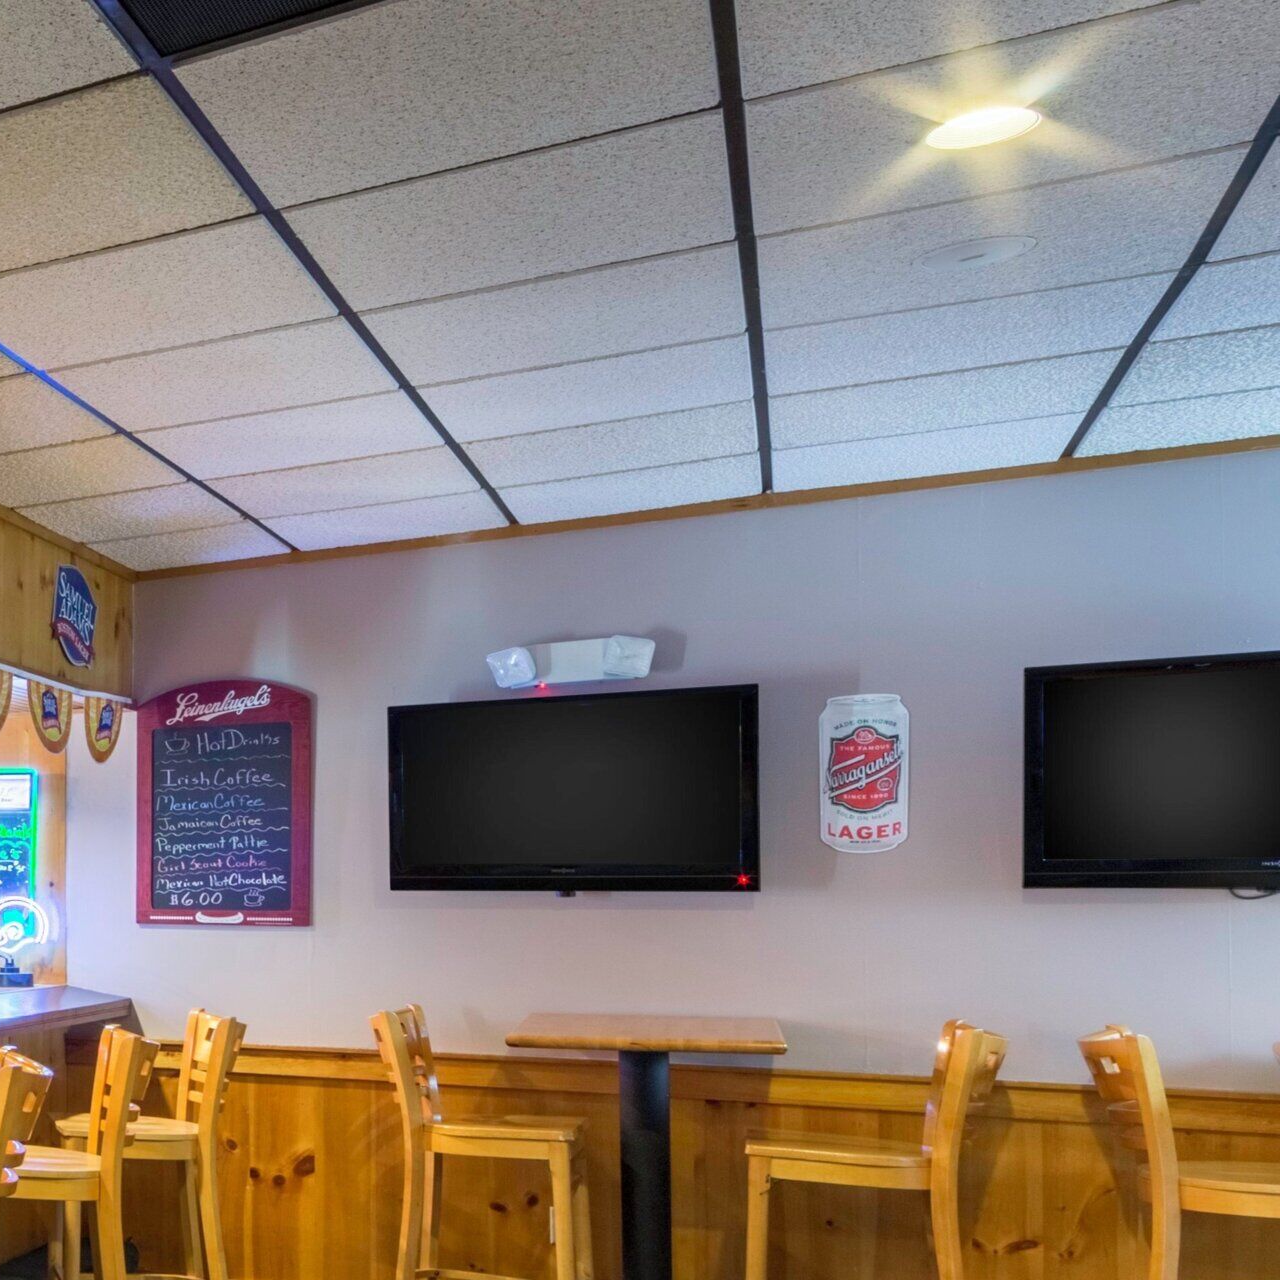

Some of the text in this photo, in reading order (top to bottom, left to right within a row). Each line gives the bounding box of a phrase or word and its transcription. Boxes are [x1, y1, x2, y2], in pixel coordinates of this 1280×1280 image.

[59, 571, 94, 630] SAMUEL
[58, 598, 90, 647] ADAMS
[196, 731, 225, 755] Hot
[857, 744, 890, 752] FAMOUS
[159, 767, 274, 787] Irish Coffee
[156, 792, 265, 811] Mexican Coffee
[156, 814, 264, 831] Jamaican Coffee
[826, 821, 902, 840] LAGER
[156, 854, 268, 873] Girl Scout Cookie
[208, 874, 229, 887] Hot
[228, 872, 288, 886] Chocolate
[169, 891, 223, 906] $6.00
